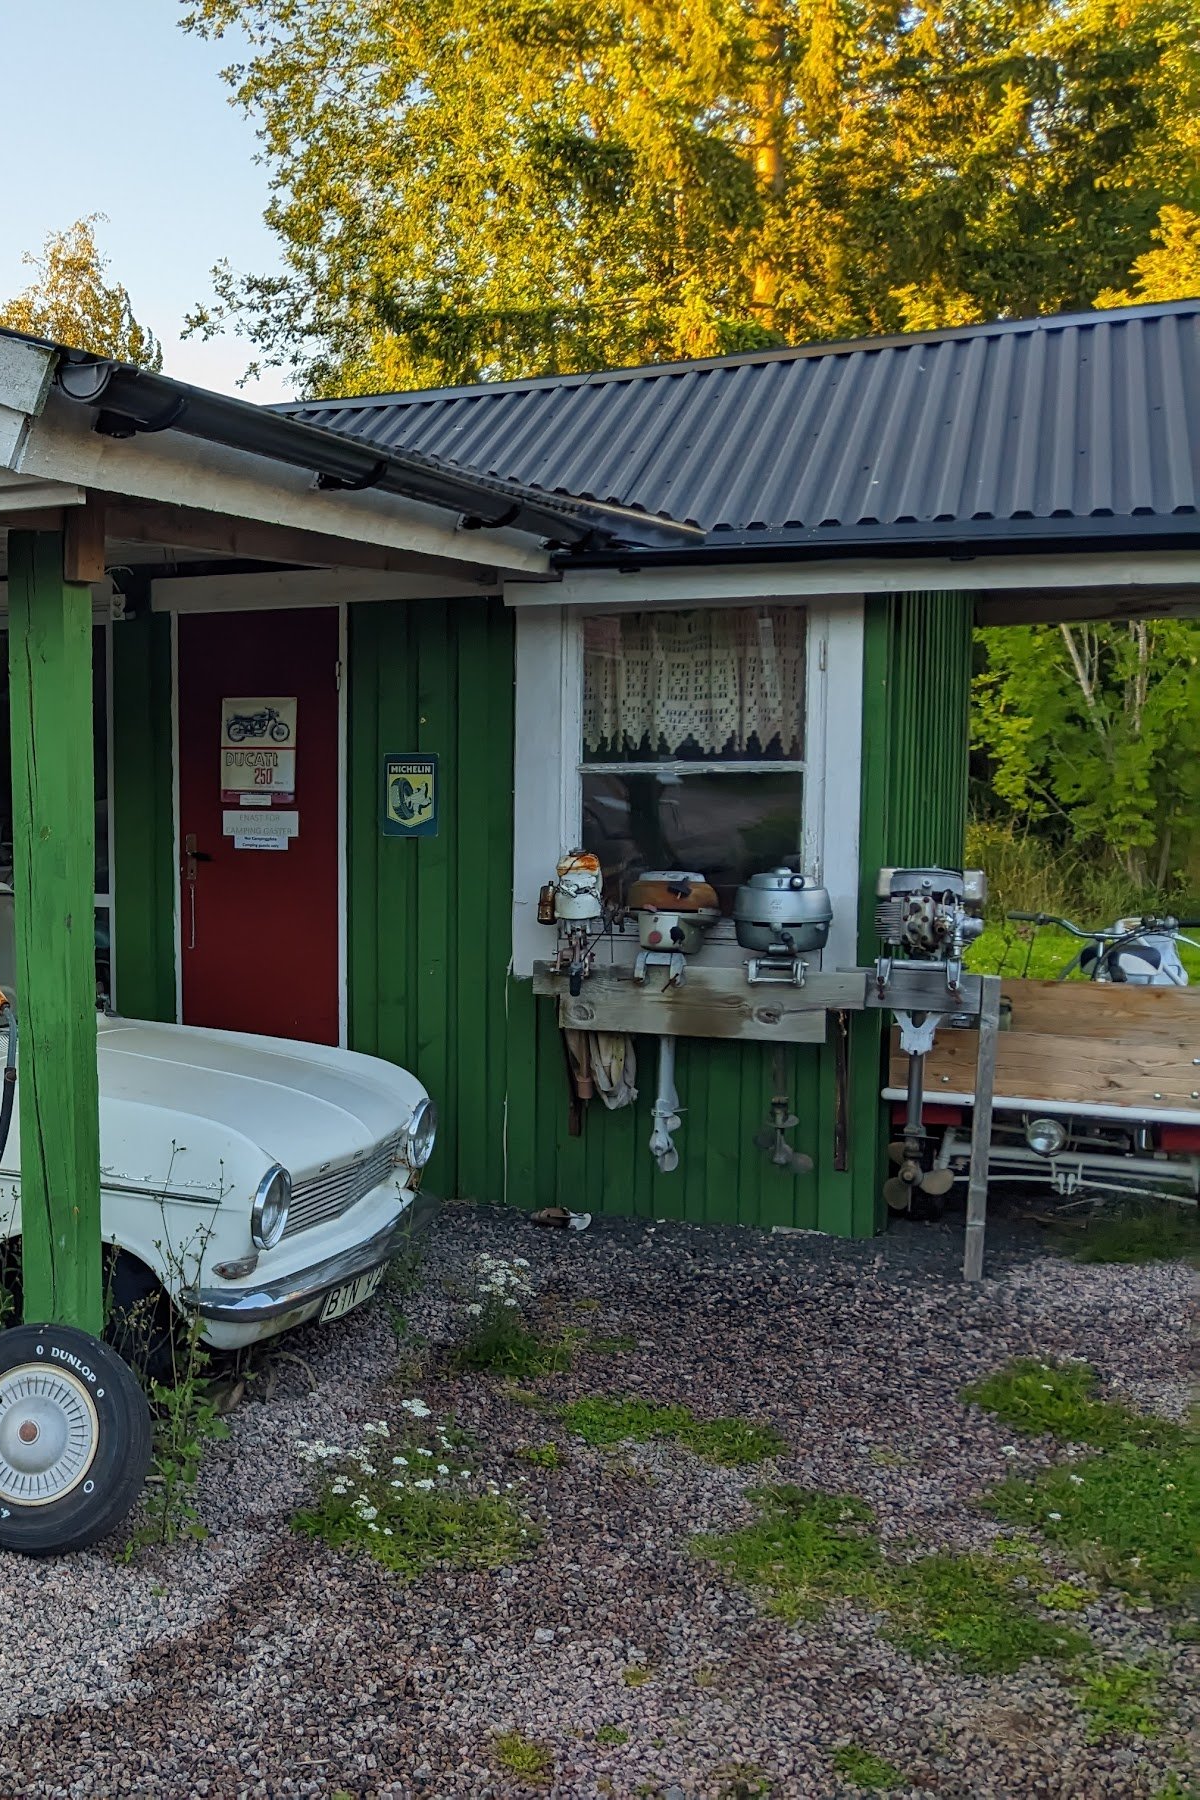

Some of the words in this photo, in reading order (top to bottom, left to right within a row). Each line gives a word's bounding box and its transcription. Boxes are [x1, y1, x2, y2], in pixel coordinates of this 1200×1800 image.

[226, 752, 278, 767] DUCATI
[254, 768, 273, 785] 250
[390, 765, 431, 774] MICHELIN
[50, 1346, 97, 1383] DUNLOP
